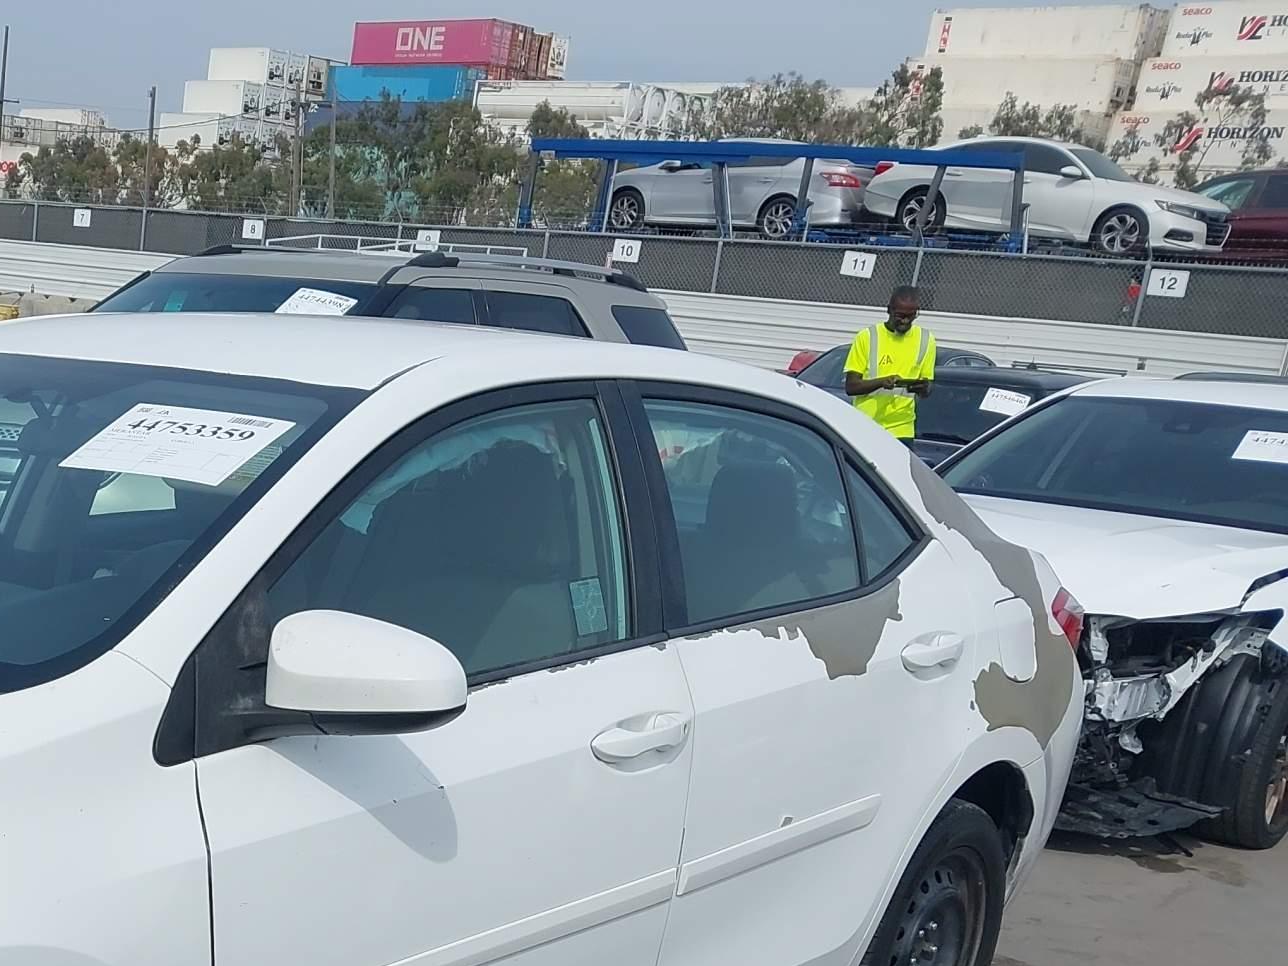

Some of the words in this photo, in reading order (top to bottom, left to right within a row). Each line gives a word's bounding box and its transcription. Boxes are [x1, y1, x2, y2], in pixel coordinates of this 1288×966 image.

[1182, 7, 1213, 16] seaco
[395, 26, 446, 51] ONE
[1151, 61, 1182, 70] seaco
[1207, 126, 1286, 139] HORIZON
[80, 214, 85, 223] 7
[250, 225, 256, 234] 8
[619, 246, 633, 257] 10
[851, 257, 867, 271] 11
[1159, 276, 1178, 290] 12
[128, 418, 256, 442] 44753359
